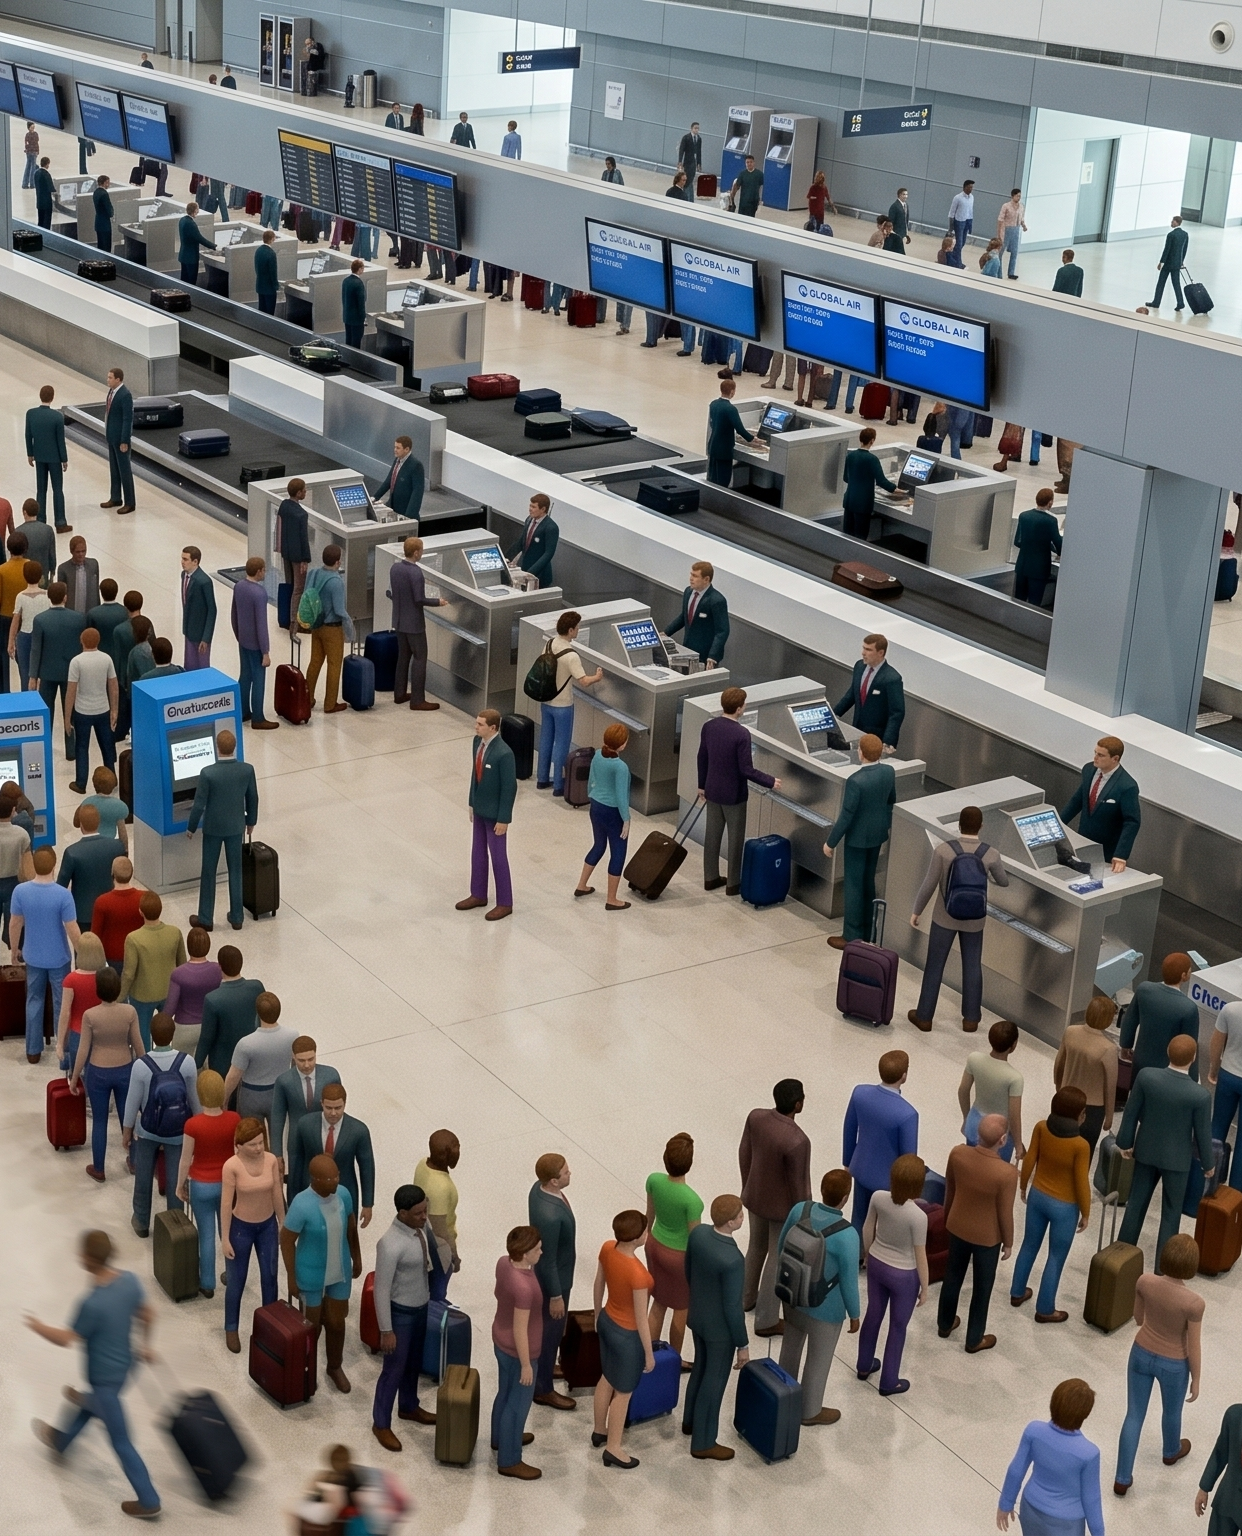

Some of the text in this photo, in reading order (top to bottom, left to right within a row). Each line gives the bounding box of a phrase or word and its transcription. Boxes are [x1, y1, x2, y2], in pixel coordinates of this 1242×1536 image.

[694, 256, 740, 276] GLOBAL AIR
[809, 288, 844, 306] GLOBAL
[846, 300, 861, 311] AIR
[912, 316, 970, 340] GLOBAL AIR
